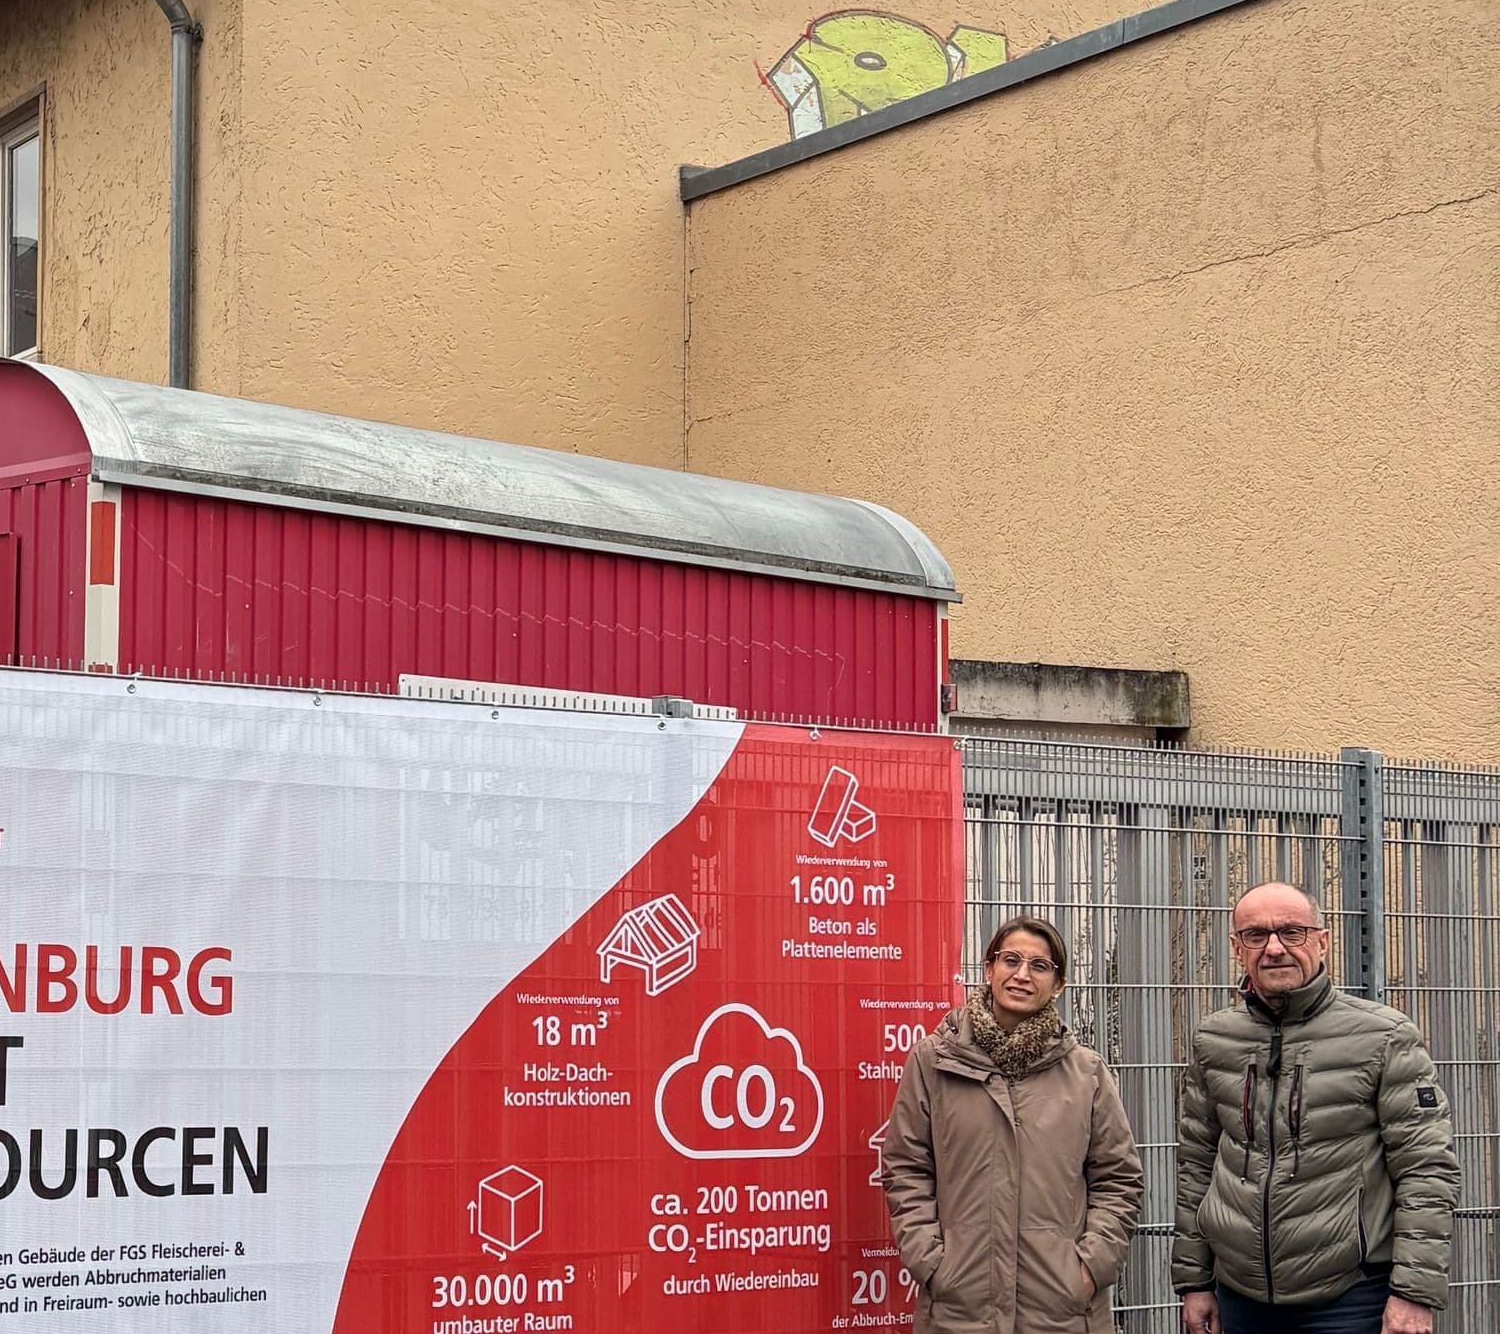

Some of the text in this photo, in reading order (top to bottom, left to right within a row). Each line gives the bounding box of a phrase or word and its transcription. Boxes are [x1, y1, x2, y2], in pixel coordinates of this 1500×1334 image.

[791, 876, 853, 905] 1.600
[809, 917, 876, 935] Beton als
[783, 939, 902, 959] Plattenelemente
[533, 1016, 560, 1045] 18
[883, 1023, 927, 1053] 500
[524, 1063, 612, 1081] Holz-Dach-
[858, 1060, 904, 1084] Stahlp
[505, 1087, 630, 1106] konstruktionen
[651, 1186, 827, 1215] ca. 200 Tonnen
[19, 1247, 85, 1264] Gebäude
[91, 1246, 115, 1261] der
[120, 1245, 146, 1260] FGS
[152, 1242, 229, 1259] Fleischerei-
[235, 1242, 245, 1256] &
[22, 1271, 79, 1288] werden
[85, 1265, 225, 1285] Abbruchmaterialien
[664, 1269, 818, 1294] durch Wiedereinbau
[852, 1270, 886, 1304] 20
[25, 1298, 37, 1312] in
[44, 1295, 113, 1311] Freiraum-
[118, 1291, 160, 1307] sowie
[166, 1287, 266, 1305] hochbaulichen
[433, 1274, 527, 1307] 30.000
[434, 1313, 572, 1334] umbauter Raum
[832, 1312, 915, 1328] der Abbruch-Em
